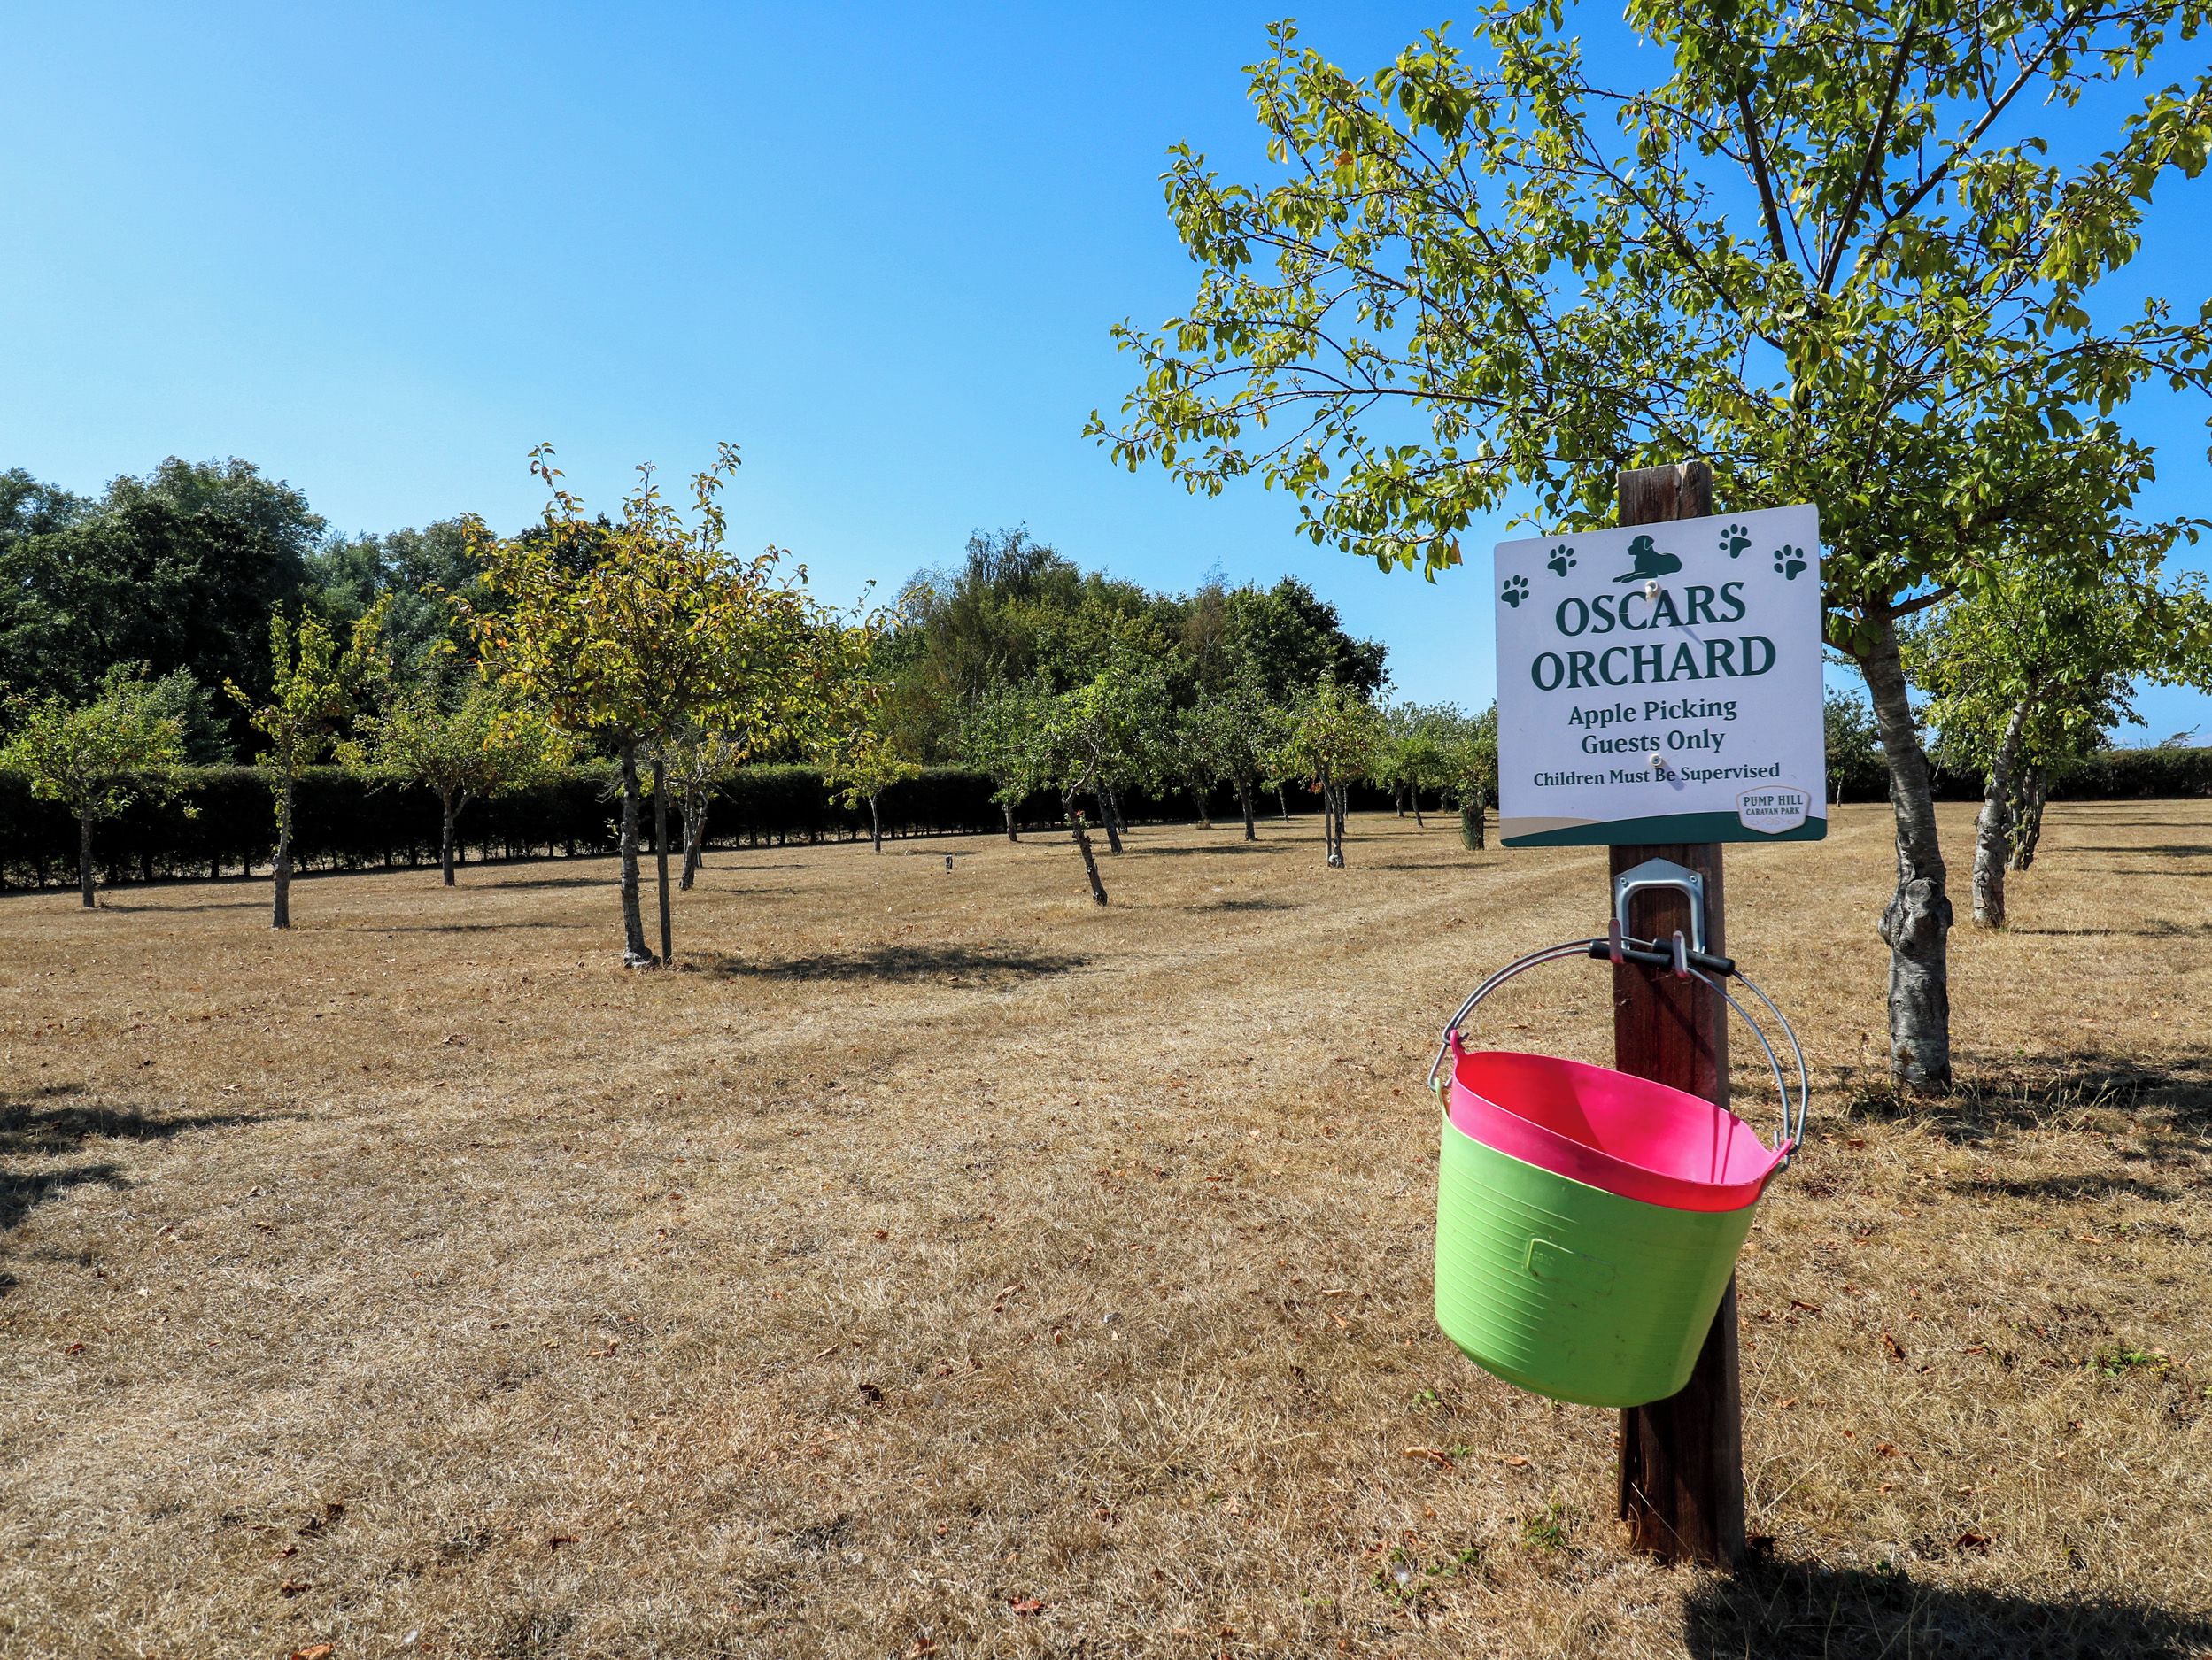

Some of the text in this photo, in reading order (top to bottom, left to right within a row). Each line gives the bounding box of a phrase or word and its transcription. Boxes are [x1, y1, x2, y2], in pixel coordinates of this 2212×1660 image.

[1555, 581, 1746, 637] OSCARS
[1530, 635, 1777, 691] ORCHARD
[1568, 698, 1738, 729] Apple Picking
[1582, 729, 1726, 755] Guests Only
[1534, 761, 1781, 787] Children Must Be Supervised
[1743, 794, 1804, 806] PUMP HILL
